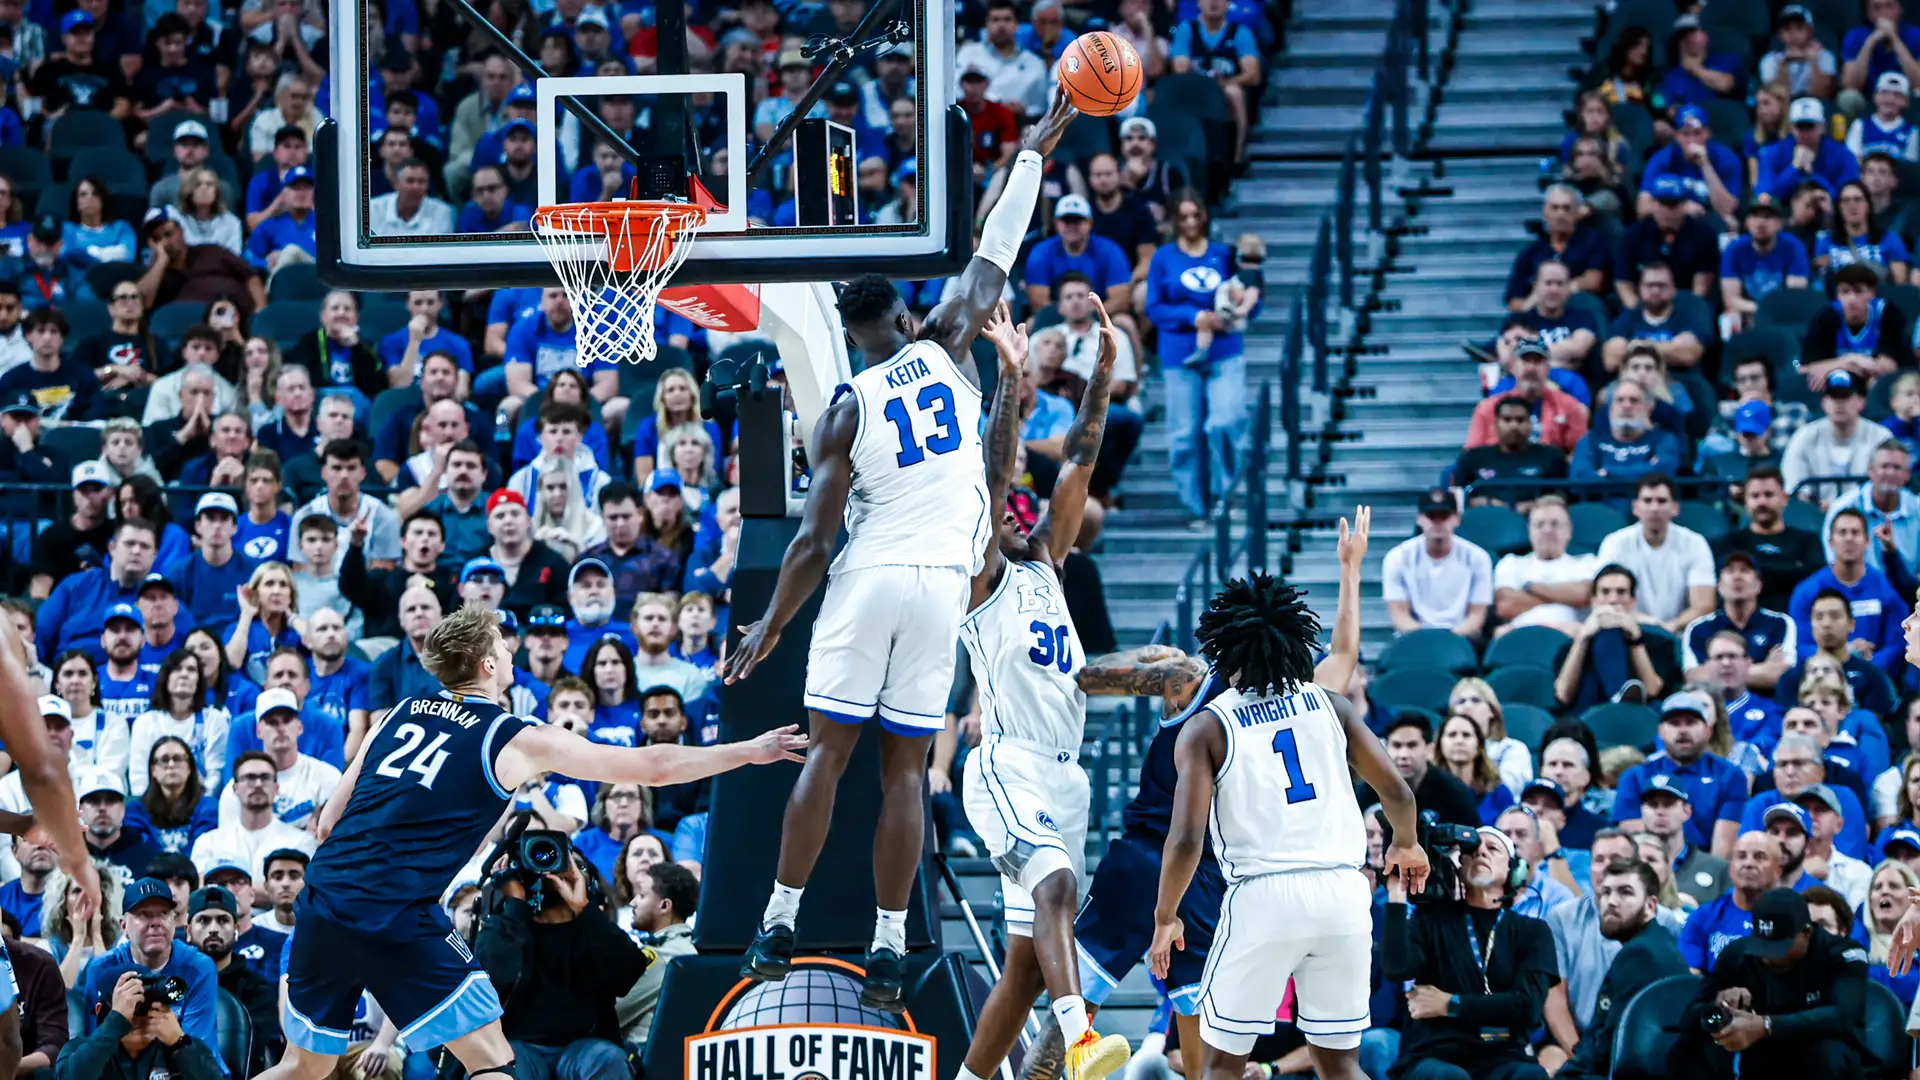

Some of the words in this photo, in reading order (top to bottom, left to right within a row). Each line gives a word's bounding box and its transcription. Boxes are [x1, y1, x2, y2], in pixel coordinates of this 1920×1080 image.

[885, 357, 931, 389] KEITA
[884, 382, 962, 468] 13
[1028, 620, 1072, 674] 30
[410, 699, 481, 729] BRENNAN
[1232, 695, 1298, 728] WRIGHT
[1302, 692, 1321, 711] III
[376, 723, 452, 790] 24
[1272, 727, 1317, 805] 1
[698, 1035, 784, 1080] HALL
[789, 1034, 822, 1067] OF
[832, 1034, 924, 1080] FAME
